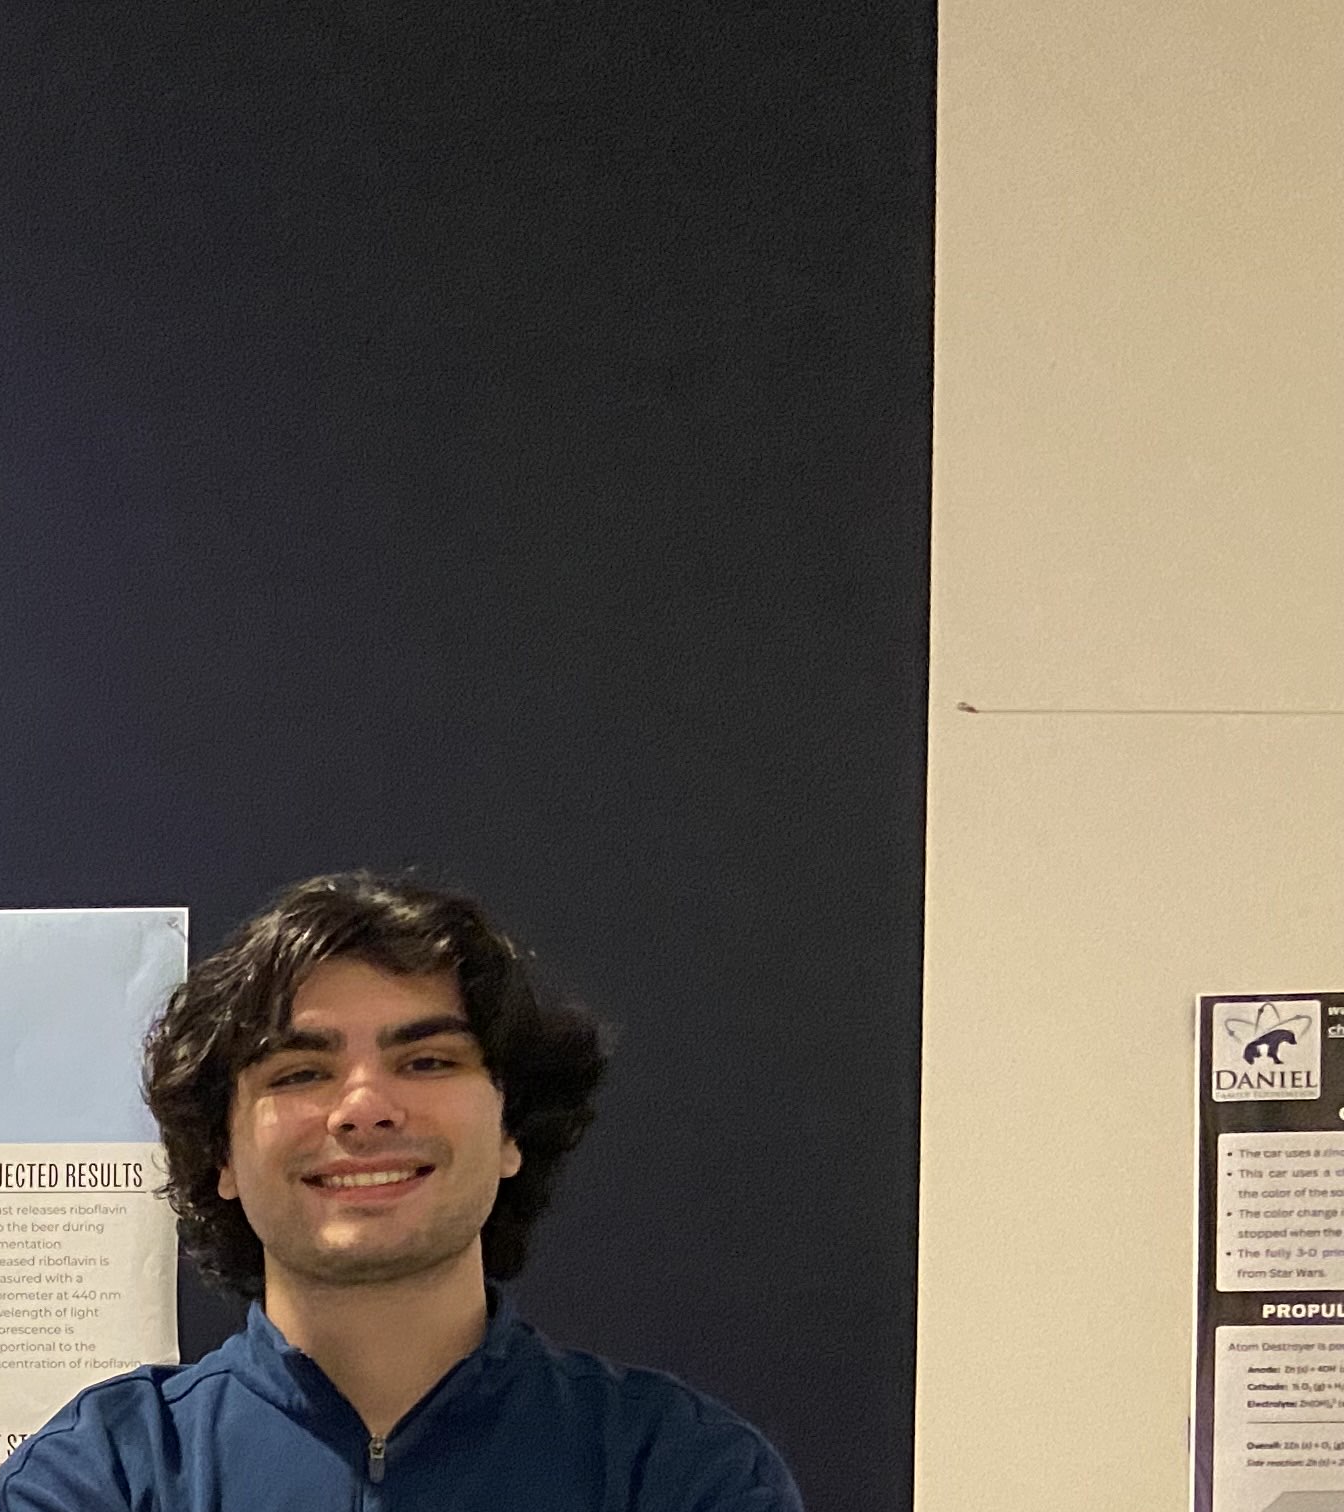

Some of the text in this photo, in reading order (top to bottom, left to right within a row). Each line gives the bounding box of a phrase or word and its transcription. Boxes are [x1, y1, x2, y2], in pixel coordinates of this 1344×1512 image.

[1216, 1070, 1318, 1090] DANIEL
[66, 1163, 142, 1187] RESULTS
[17, 1205, 66, 1215] releases
[70, 1204, 126, 1215] riboflavin
[39, 1256, 96, 1266] riboflavin
[100, 1256, 109, 1266] is
[57, 1292, 68, 1300] at
[72, 1290, 96, 1300] 440
[100, 1292, 121, 1300] nm
[1262, 1303, 1344, 1318] PROPUL
